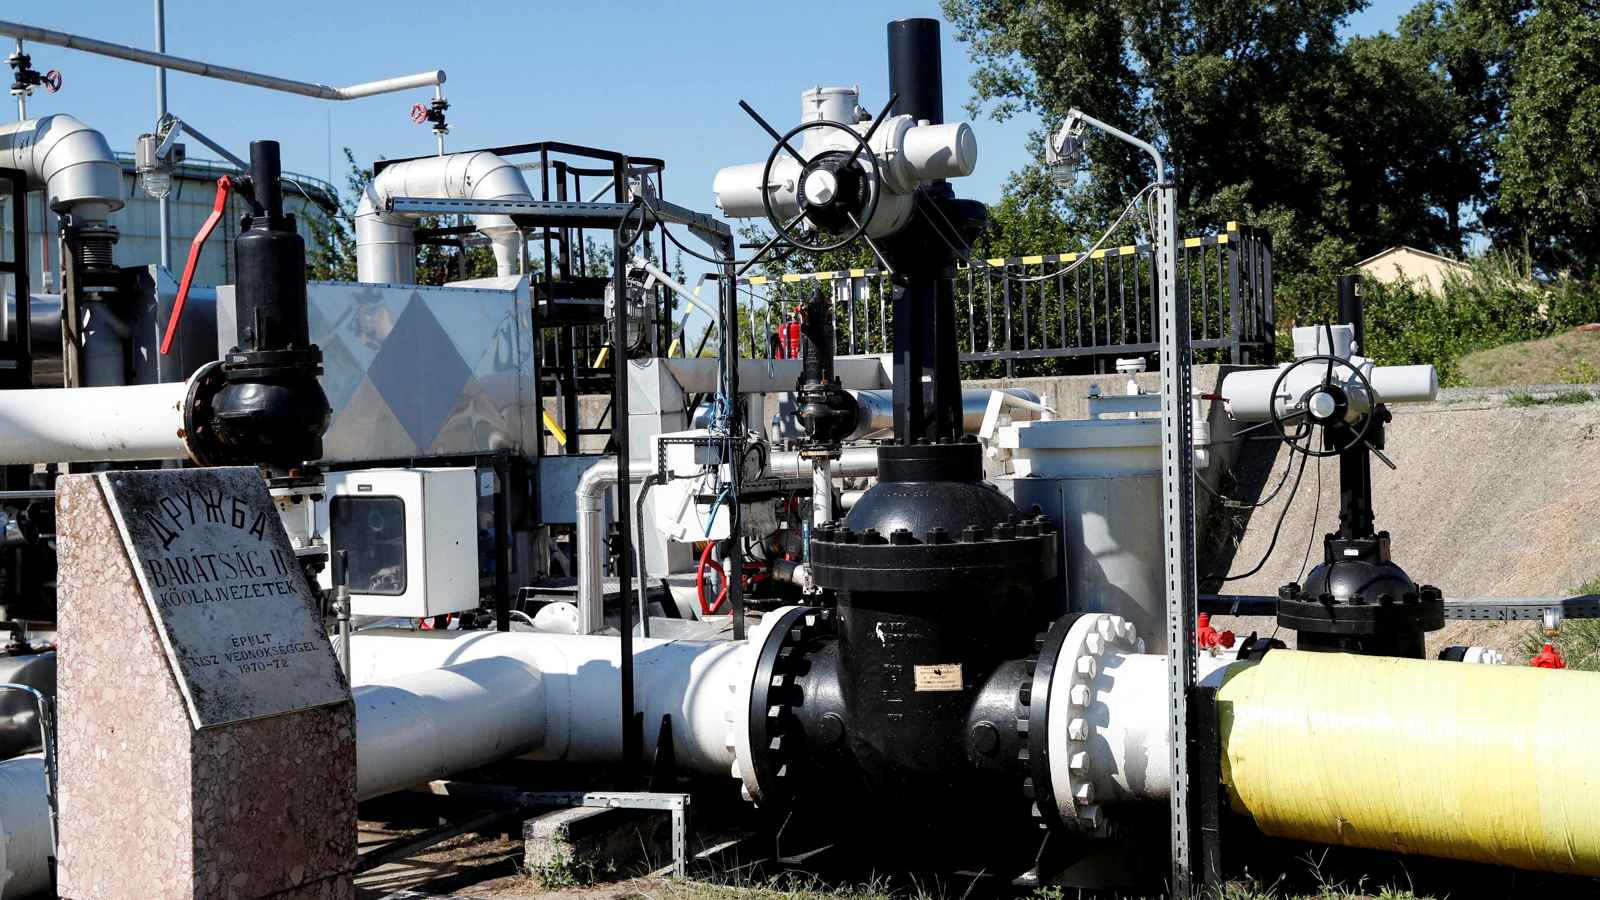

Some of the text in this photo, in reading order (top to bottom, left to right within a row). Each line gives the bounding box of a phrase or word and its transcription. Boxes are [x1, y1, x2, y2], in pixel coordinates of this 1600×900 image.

[145, 490, 269, 551] ДРУЖБА
[149, 546, 266, 588] BARÁTSÁG
[238, 659, 289, 674] 1970-72
